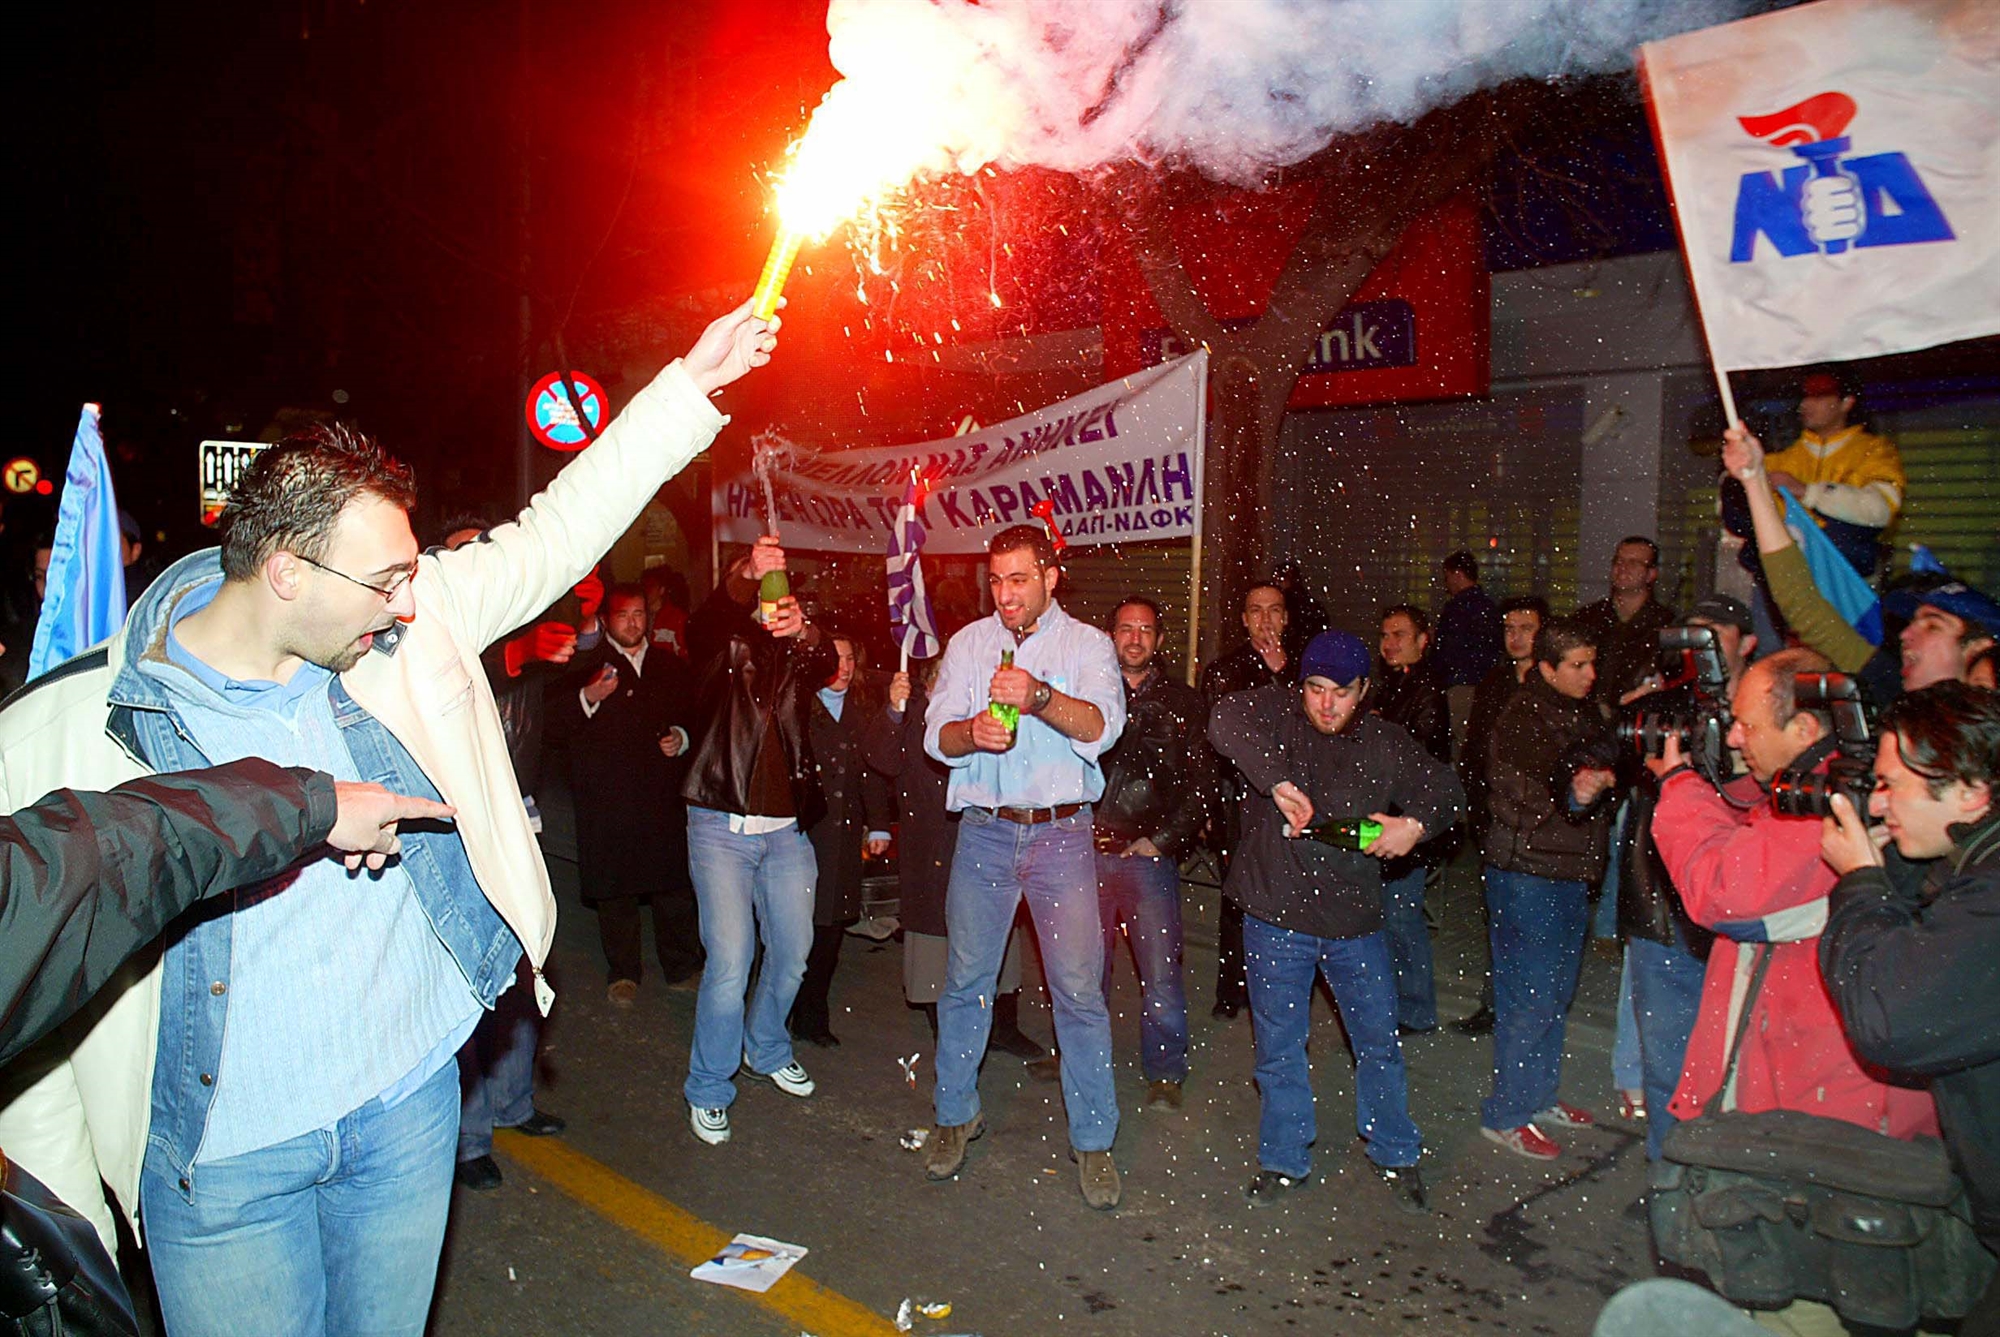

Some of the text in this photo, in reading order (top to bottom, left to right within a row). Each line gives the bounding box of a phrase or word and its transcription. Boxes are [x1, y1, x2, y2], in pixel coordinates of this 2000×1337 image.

[987, 399, 1120, 470] ΑΝΗΚΕΙ
[937, 452, 1193, 530] ΚΑΡΑΜΑΝΛΗ
[1061, 505, 1193, 538] ΔΑΠ-ΝΔΦΚ
